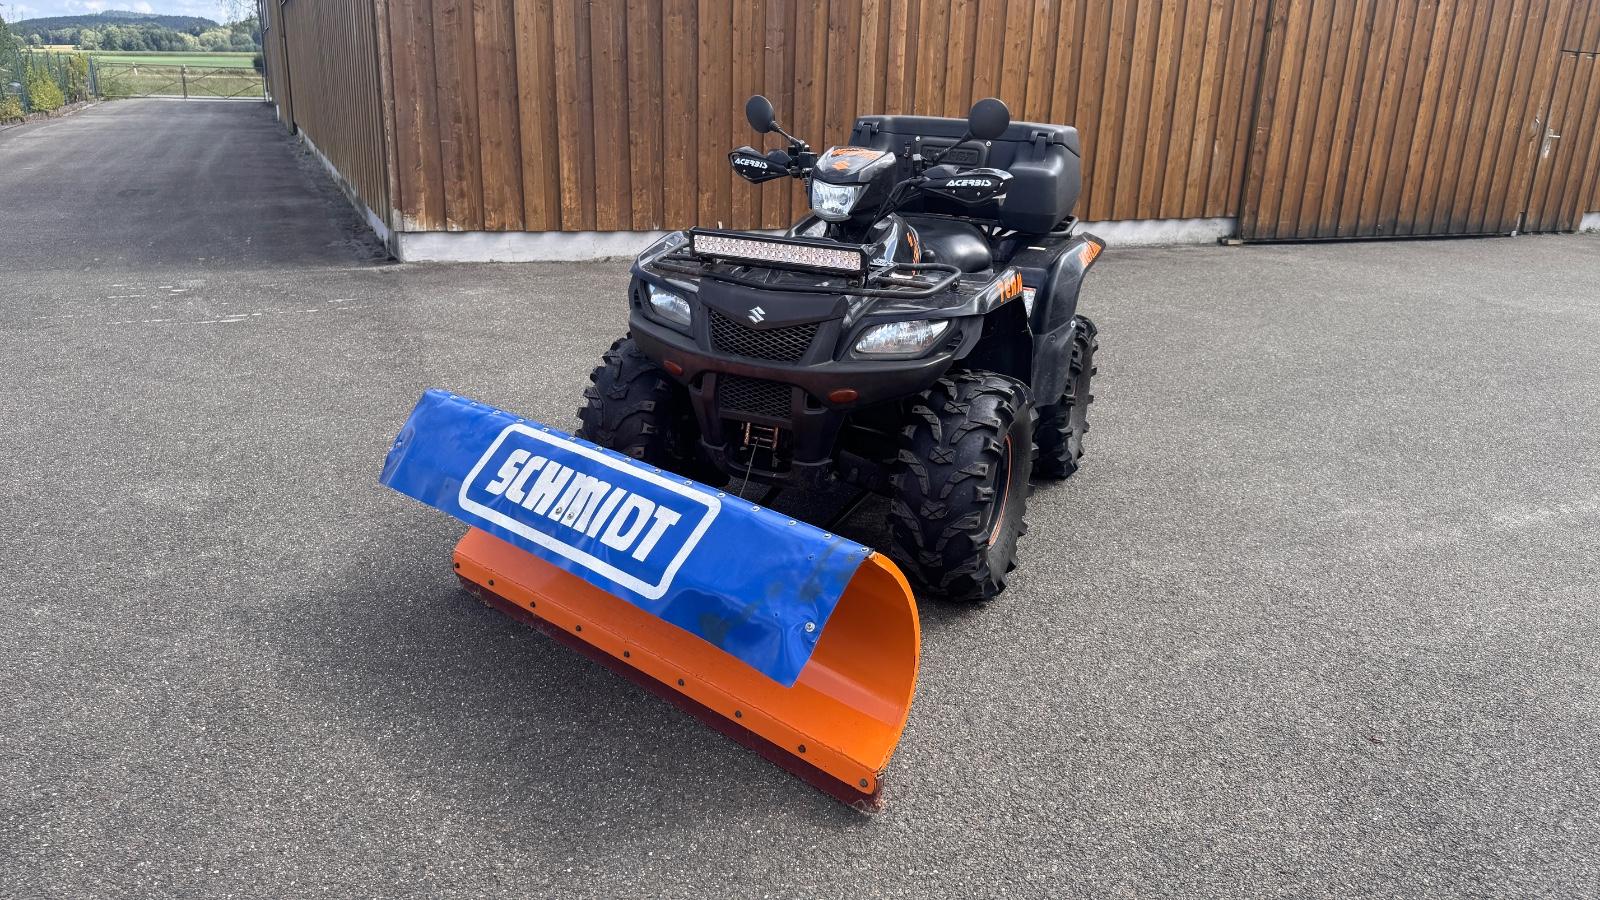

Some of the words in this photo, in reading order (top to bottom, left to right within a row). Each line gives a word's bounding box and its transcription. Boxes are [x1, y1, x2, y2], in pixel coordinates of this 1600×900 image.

[735, 158, 768, 169] ACERBIS
[946, 179, 992, 187] ACERBIS
[485, 449, 682, 562] SCHMIDT
